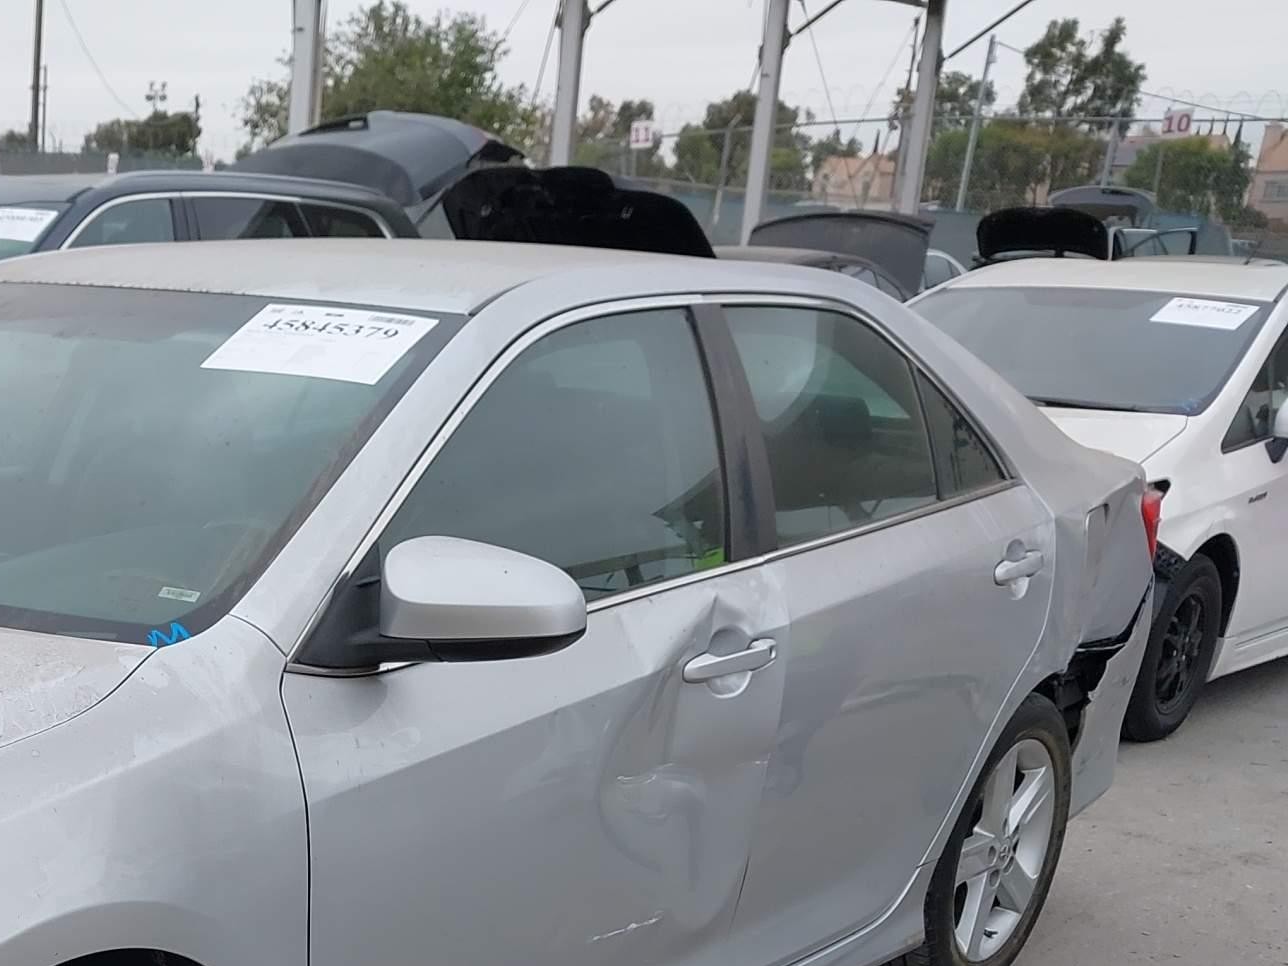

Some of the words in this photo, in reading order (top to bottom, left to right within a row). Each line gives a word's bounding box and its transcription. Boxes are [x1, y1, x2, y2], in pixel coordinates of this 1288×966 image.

[1163, 113, 1191, 134] 10
[632, 126, 650, 143] 11
[263, 318, 399, 340] 45845379
